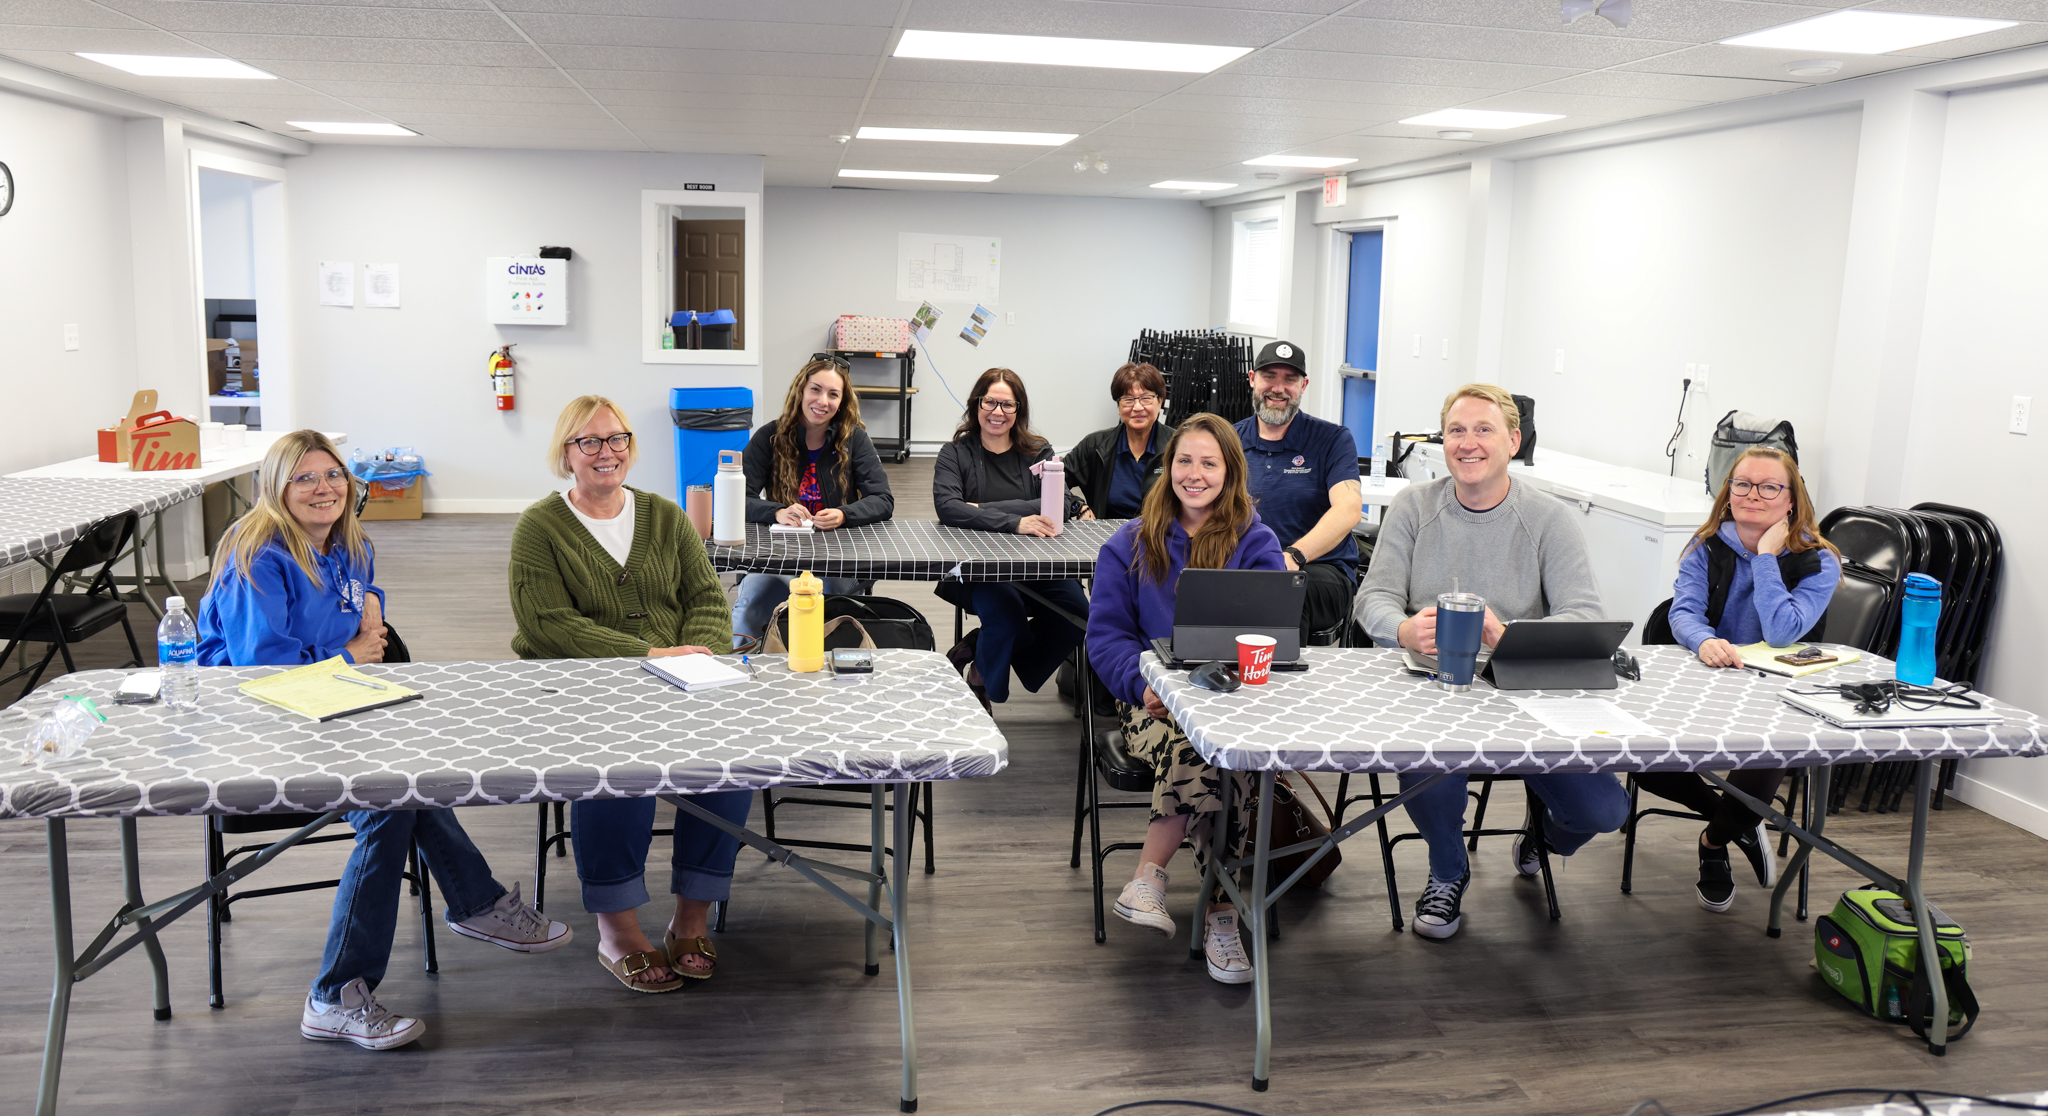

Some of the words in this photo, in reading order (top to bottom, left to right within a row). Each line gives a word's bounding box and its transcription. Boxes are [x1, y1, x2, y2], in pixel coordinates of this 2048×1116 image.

[1326, 179, 1339, 203] EXIT
[131, 431, 197, 471] Tim
[168, 647, 194, 656] AQUAFINA
[1250, 647, 1272, 665] Tim
